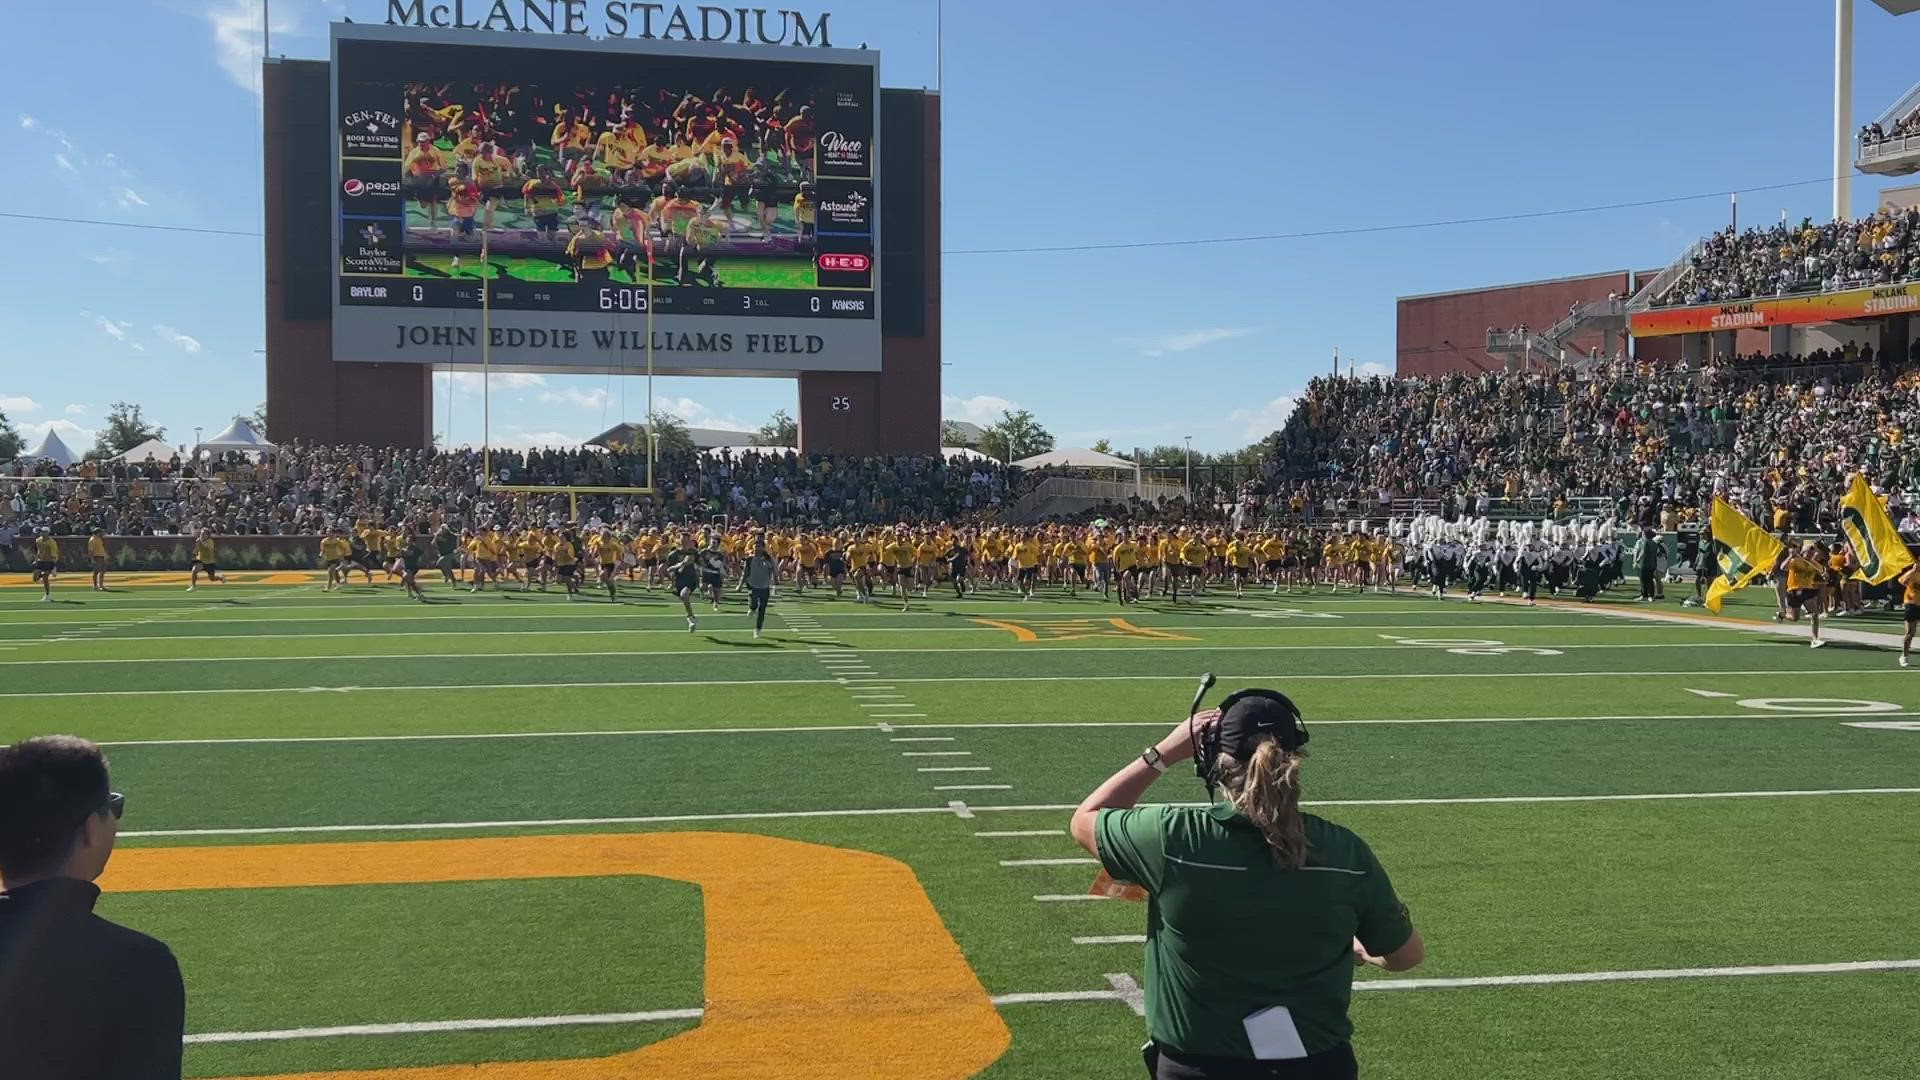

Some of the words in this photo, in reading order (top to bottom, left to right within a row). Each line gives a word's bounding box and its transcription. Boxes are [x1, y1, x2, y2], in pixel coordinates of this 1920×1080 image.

[384, 0, 590, 35] McLANE
[604, 1, 833, 47] STADIUM
[345, 110, 399, 128] CEN-TEX
[821, 131, 862, 152] Waco
[366, 181, 400, 192] pepsi
[820, 201, 857, 212] Astound
[350, 286, 387, 298] BAYLOR
[412, 285, 423, 301] 0
[599, 288, 647, 310] 6:06
[743, 295, 751, 309] 3
[810, 296, 820, 312] 0
[831, 299, 865, 311] KANSAS
[1864, 294, 1918, 312] STADIUM
[1711, 311, 1765, 328] STADIUM
[396, 325, 477, 349] JOHN
[488, 327, 579, 349] EDDIE
[592, 329, 733, 353] WILLIAMS
[746, 333, 825, 354] FIELD
[832, 396, 850, 410] 25
